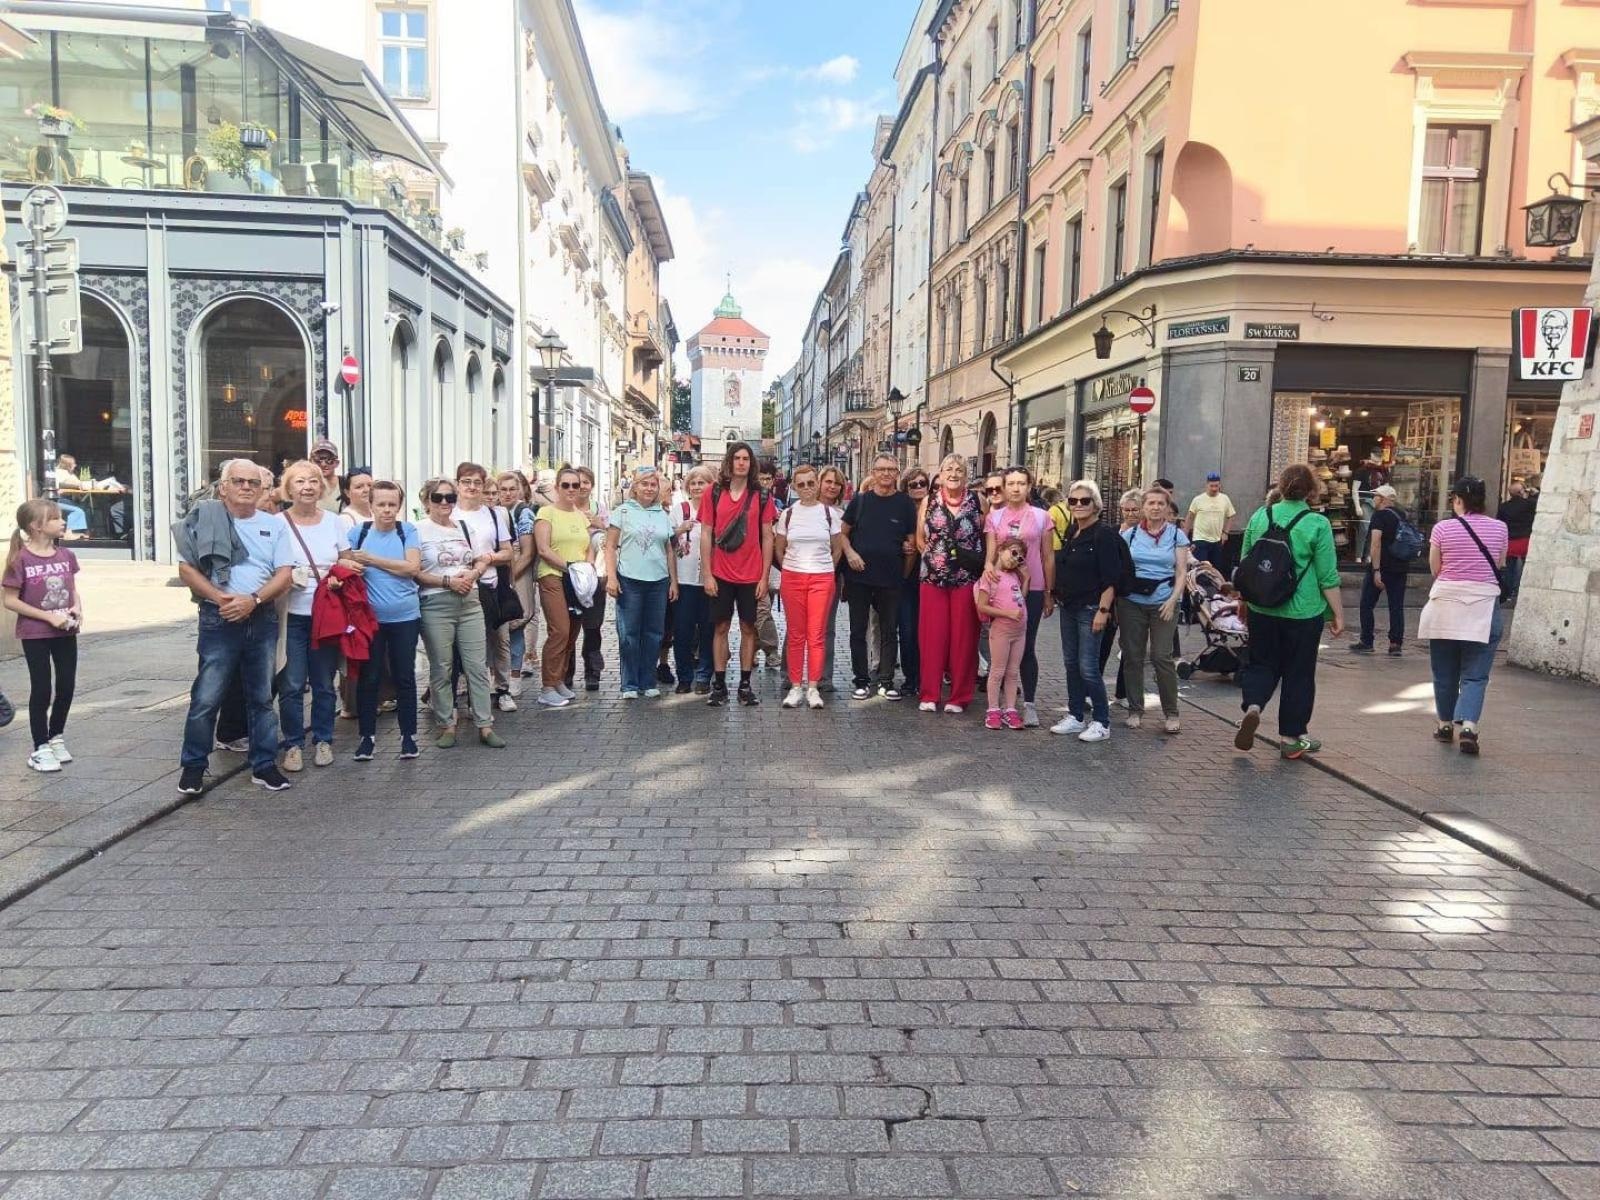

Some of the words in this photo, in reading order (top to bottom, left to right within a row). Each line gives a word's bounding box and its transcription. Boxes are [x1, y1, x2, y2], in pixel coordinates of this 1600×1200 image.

[1243, 371, 1257, 380] 20
[1530, 361, 1575, 376] KFC
[25, 562, 70, 578] BEARY
